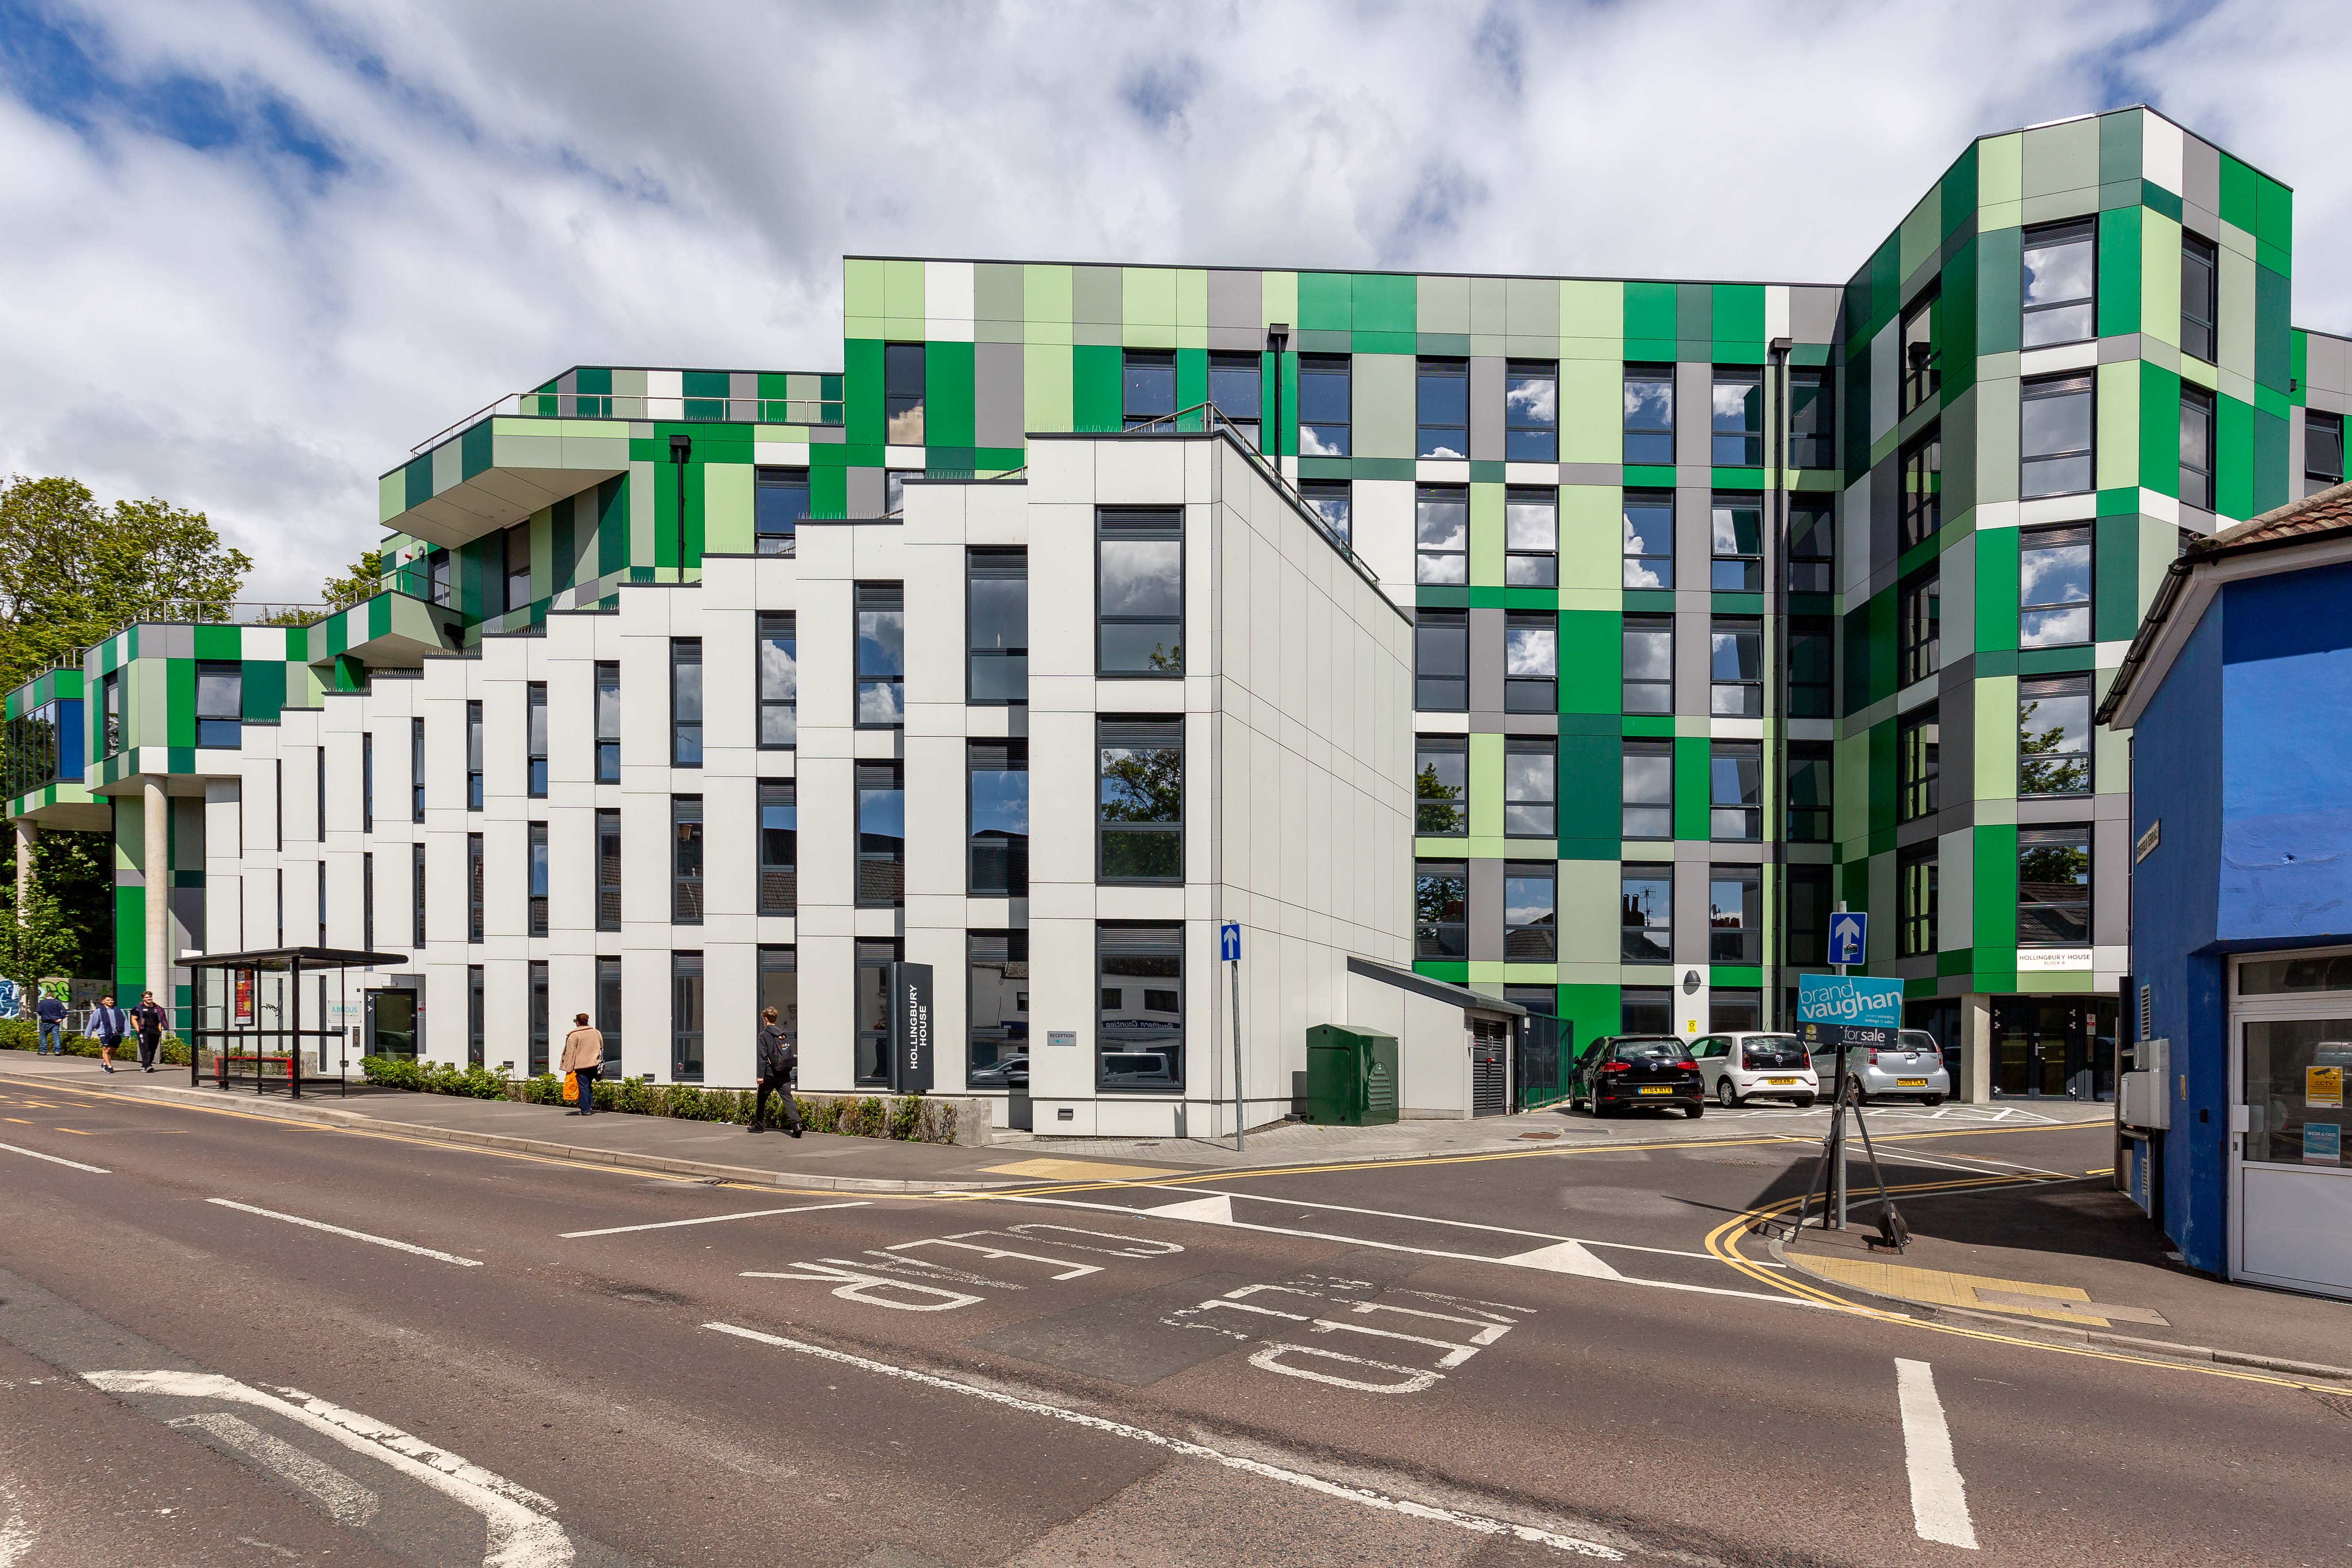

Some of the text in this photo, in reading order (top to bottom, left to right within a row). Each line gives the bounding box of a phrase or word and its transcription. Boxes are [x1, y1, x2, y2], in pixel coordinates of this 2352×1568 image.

[1799, 978, 1854, 1005] brand
[1802, 991, 1901, 1019] vaughan
[1844, 1026, 1885, 1042] for sale
